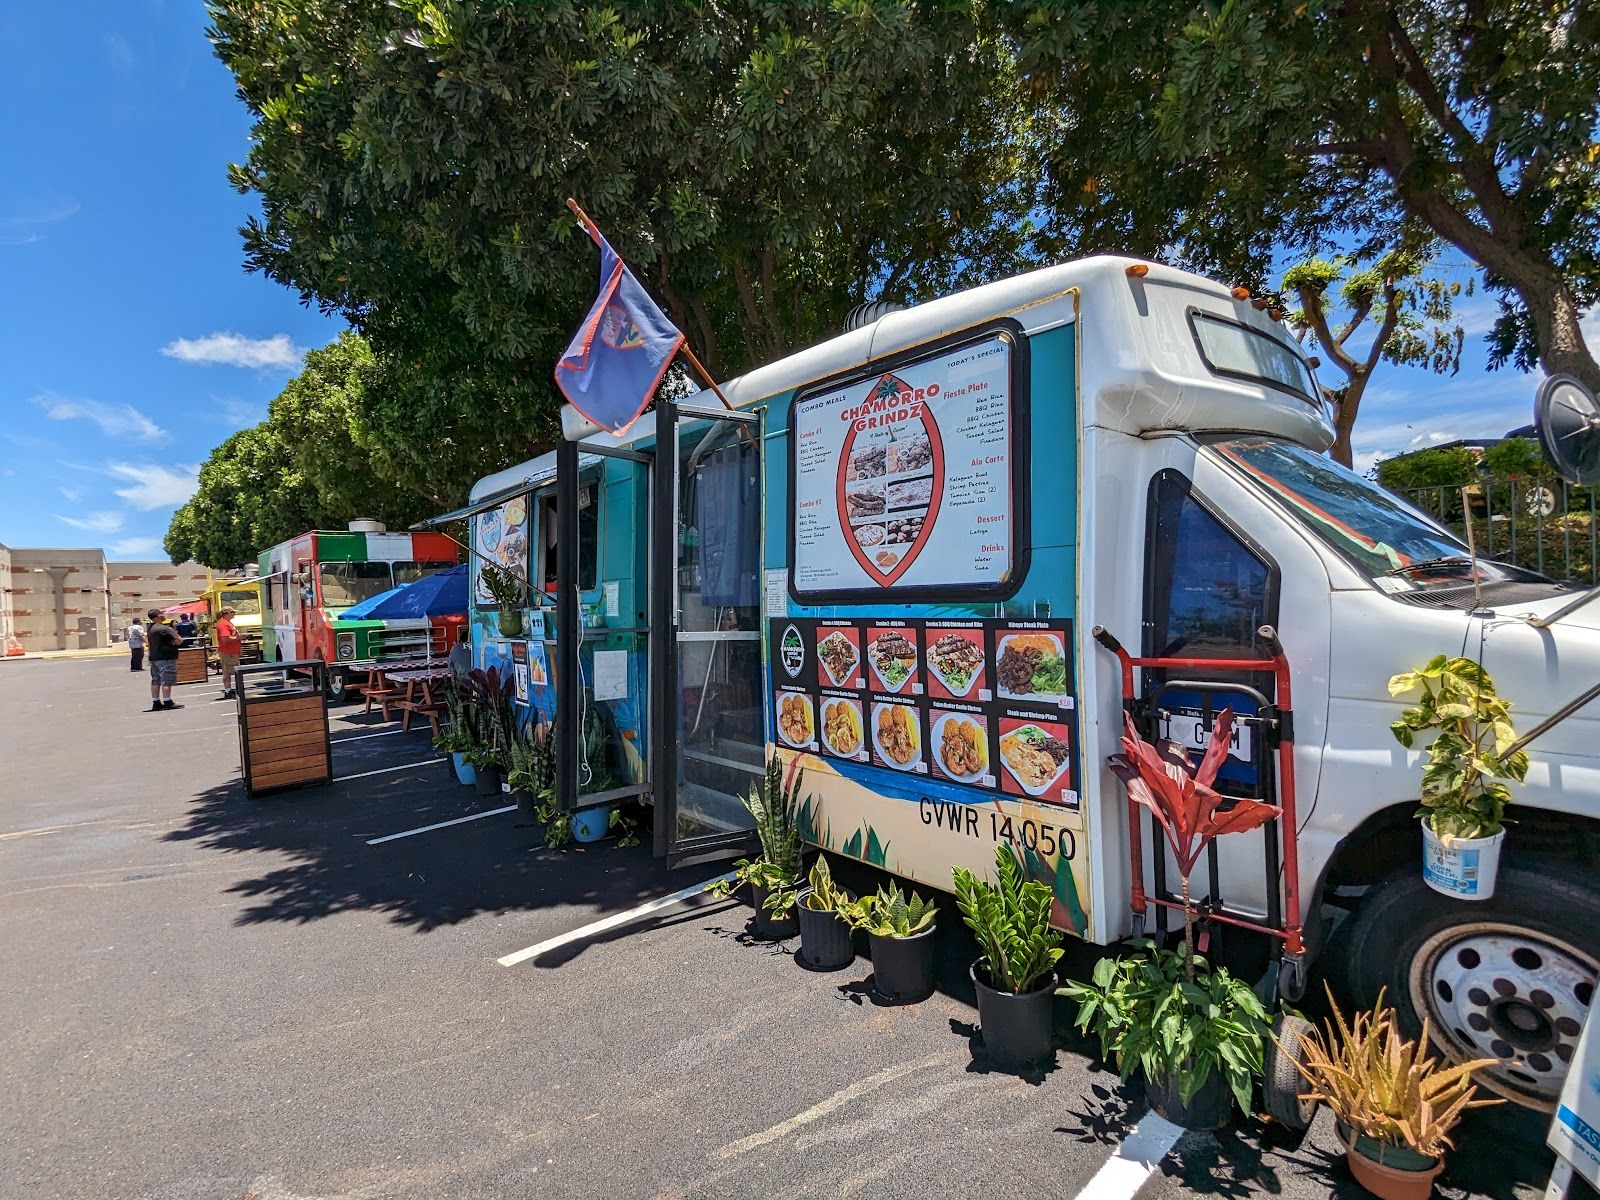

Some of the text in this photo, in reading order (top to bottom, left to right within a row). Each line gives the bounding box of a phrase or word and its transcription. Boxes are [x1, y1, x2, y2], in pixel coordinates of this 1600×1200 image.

[947, 347, 1004, 368] TODAY'S SPECIAL
[943, 382, 989, 400] Fiesta Plate
[801, 395, 846, 414] COMBO MEALS
[840, 383, 940, 421] CHAMORRO
[855, 403, 923, 432] GRINDZ
[971, 457, 983, 466] Ala
[977, 514, 1004, 524] Dessert
[981, 544, 1005, 552] Drinks
[1194, 722, 1240, 751] GM
[919, 796, 979, 838] GVWR
[1577, 1119, 1600, 1146] TAS
